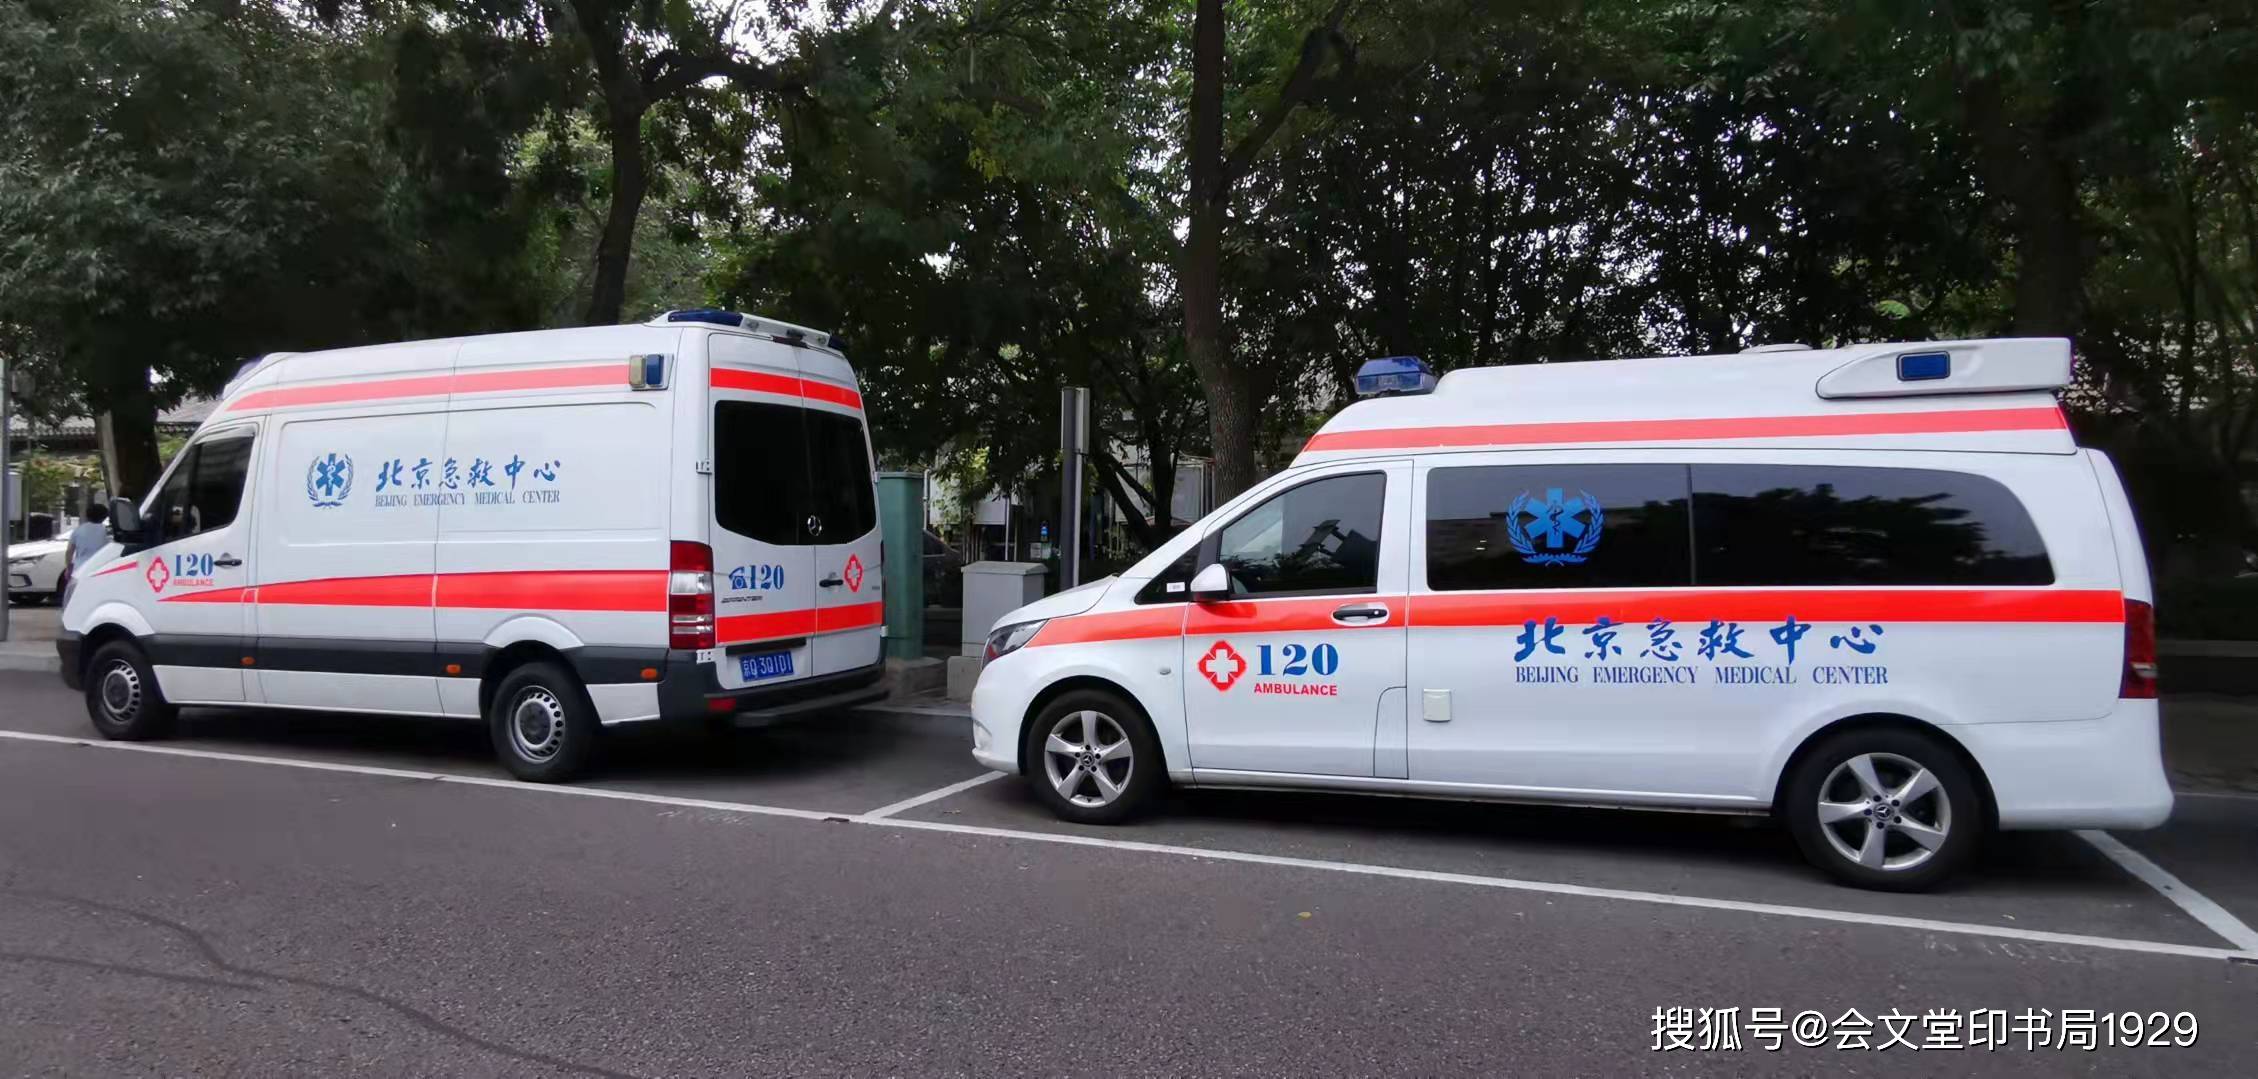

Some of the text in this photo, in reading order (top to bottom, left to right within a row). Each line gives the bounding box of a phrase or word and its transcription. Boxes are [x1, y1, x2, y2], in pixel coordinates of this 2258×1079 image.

[375, 454, 561, 492] 北京急救中心
[375, 489, 560, 507] BEIJING EMERGENCY MEDICAL CENTER
[175, 553, 214, 576] 120
[750, 565, 785, 590] 120
[1514, 615, 1885, 664] 北京急救中心
[1256, 643, 1339, 676] 120
[1515, 666, 1889, 684] BEIJING EMERGENCY MEDICAL CENTER
[1254, 683, 1338, 696] AMBULANCE
